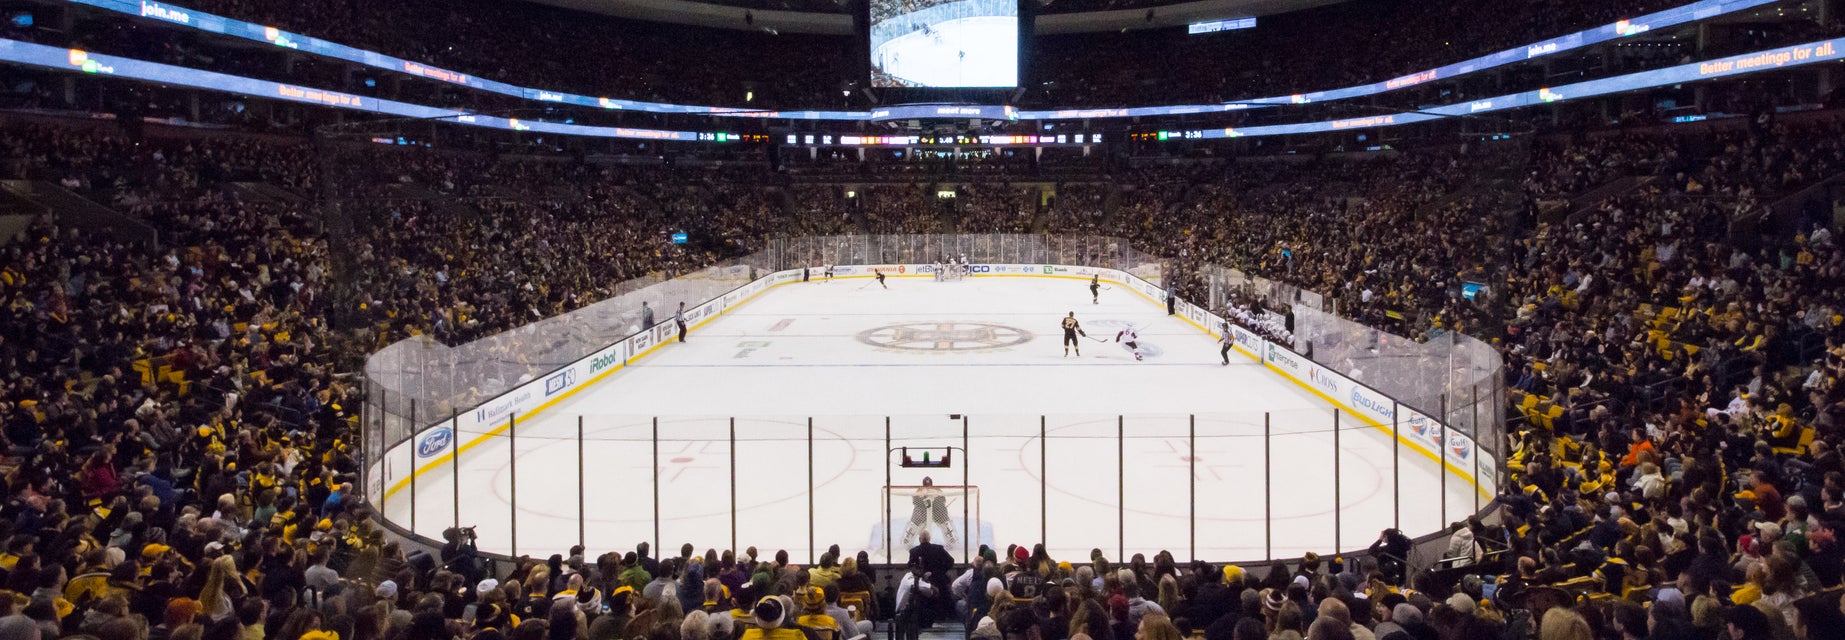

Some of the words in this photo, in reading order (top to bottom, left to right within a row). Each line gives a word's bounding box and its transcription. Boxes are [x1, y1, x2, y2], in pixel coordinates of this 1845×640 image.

[141, 0, 189, 23] join.me
[1528, 42, 1556, 58] join.me
[1700, 61, 1734, 75] Better
[1736, 51, 1791, 69] meetings
[1793, 47, 1812, 60] for
[1815, 42, 1836, 57] all.
[699, 132, 715, 141] 3:36
[1185, 130, 1202, 139] 3:36
[590, 349, 616, 374] iRobot
[1410, 417, 1425, 425] Gulf
[423, 432, 448, 455] Ford
[1450, 438, 1466, 447] Gulf
